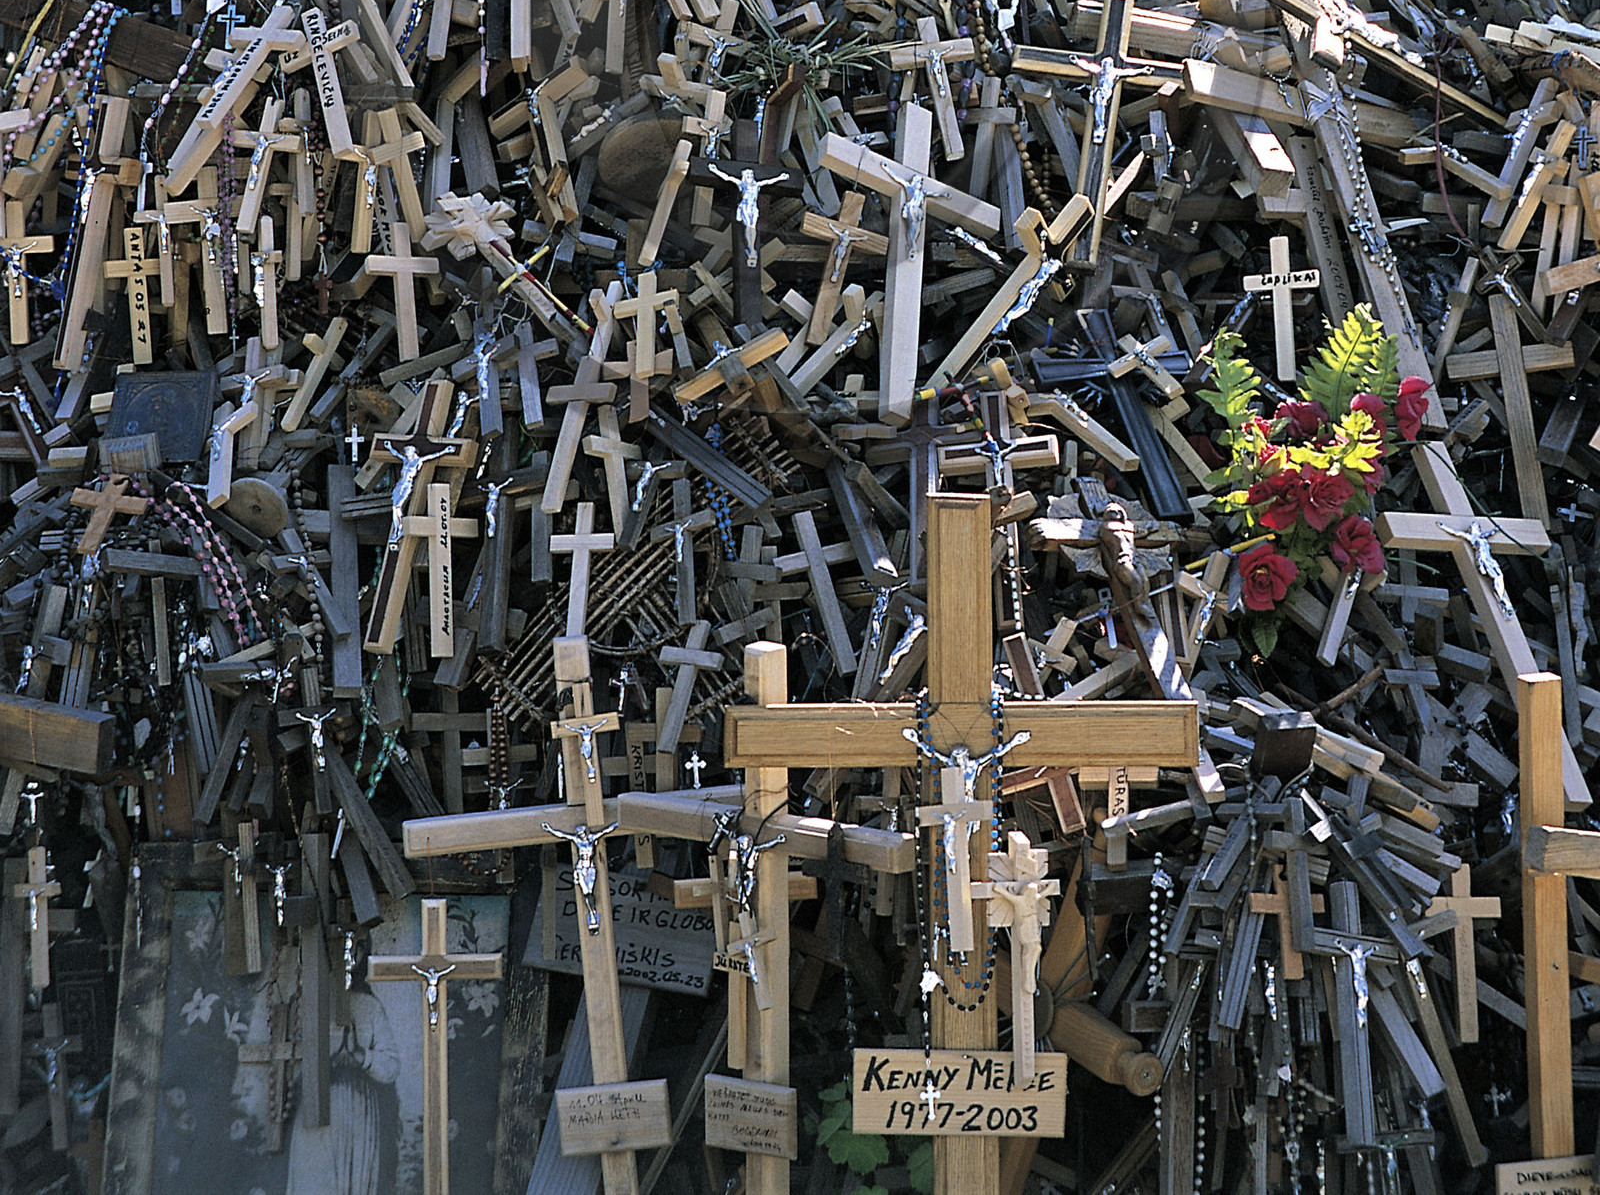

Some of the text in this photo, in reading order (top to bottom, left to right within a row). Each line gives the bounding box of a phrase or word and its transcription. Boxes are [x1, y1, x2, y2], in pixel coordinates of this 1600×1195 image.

[129, 232, 144, 286] ANTAS
[861, 1055, 961, 1093] KENNY
[885, 1100, 1039, 1133] 1977-2003
